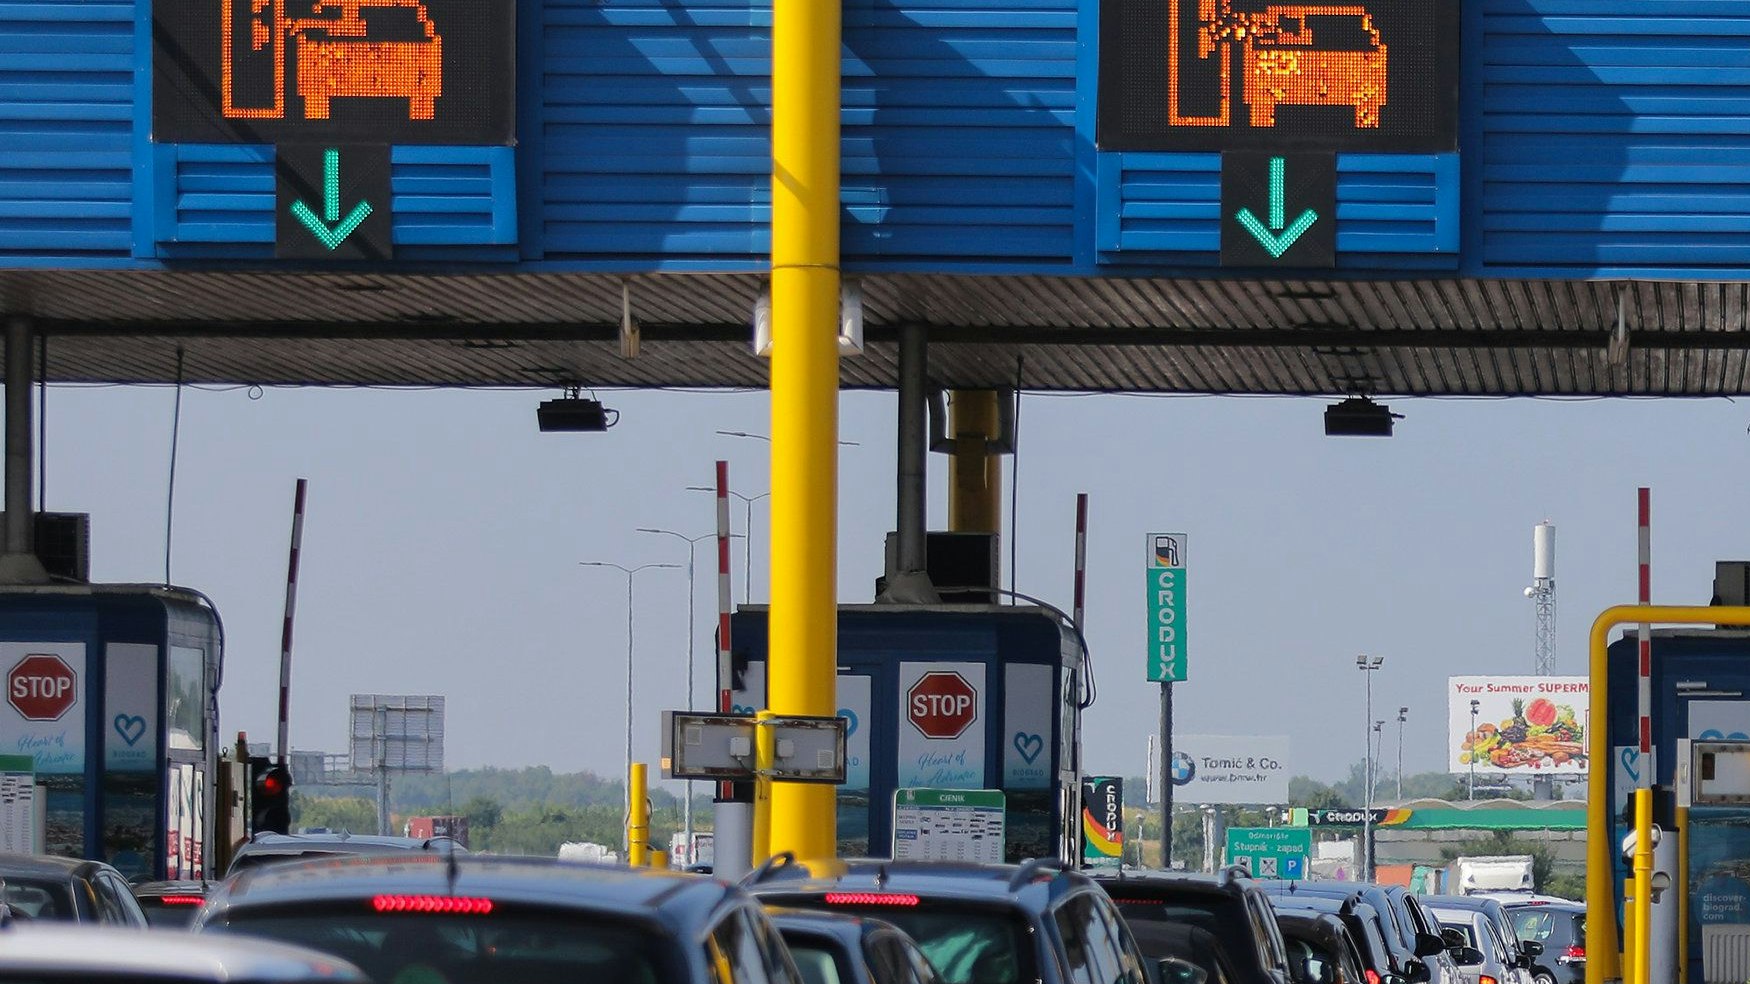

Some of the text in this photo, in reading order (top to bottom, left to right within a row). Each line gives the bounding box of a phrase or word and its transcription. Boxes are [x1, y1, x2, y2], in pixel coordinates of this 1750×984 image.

[1158, 571, 1176, 679] CRODUX
[13, 676, 71, 698] STOP
[1456, 682, 1589, 693] Your Summer SUPERM
[913, 694, 971, 717] STOP
[1201, 757, 1282, 770] Tomić & Co.
[1106, 785, 1117, 841] CRODUX
[1326, 811, 1378, 822] CRODUX
[1234, 841, 1268, 853] Stupnik
[1277, 844, 1303, 854] zapad
[1287, 860, 1297, 872] P
[1703, 893, 1747, 902] discover-
[1703, 902, 1743, 912] biograd.
